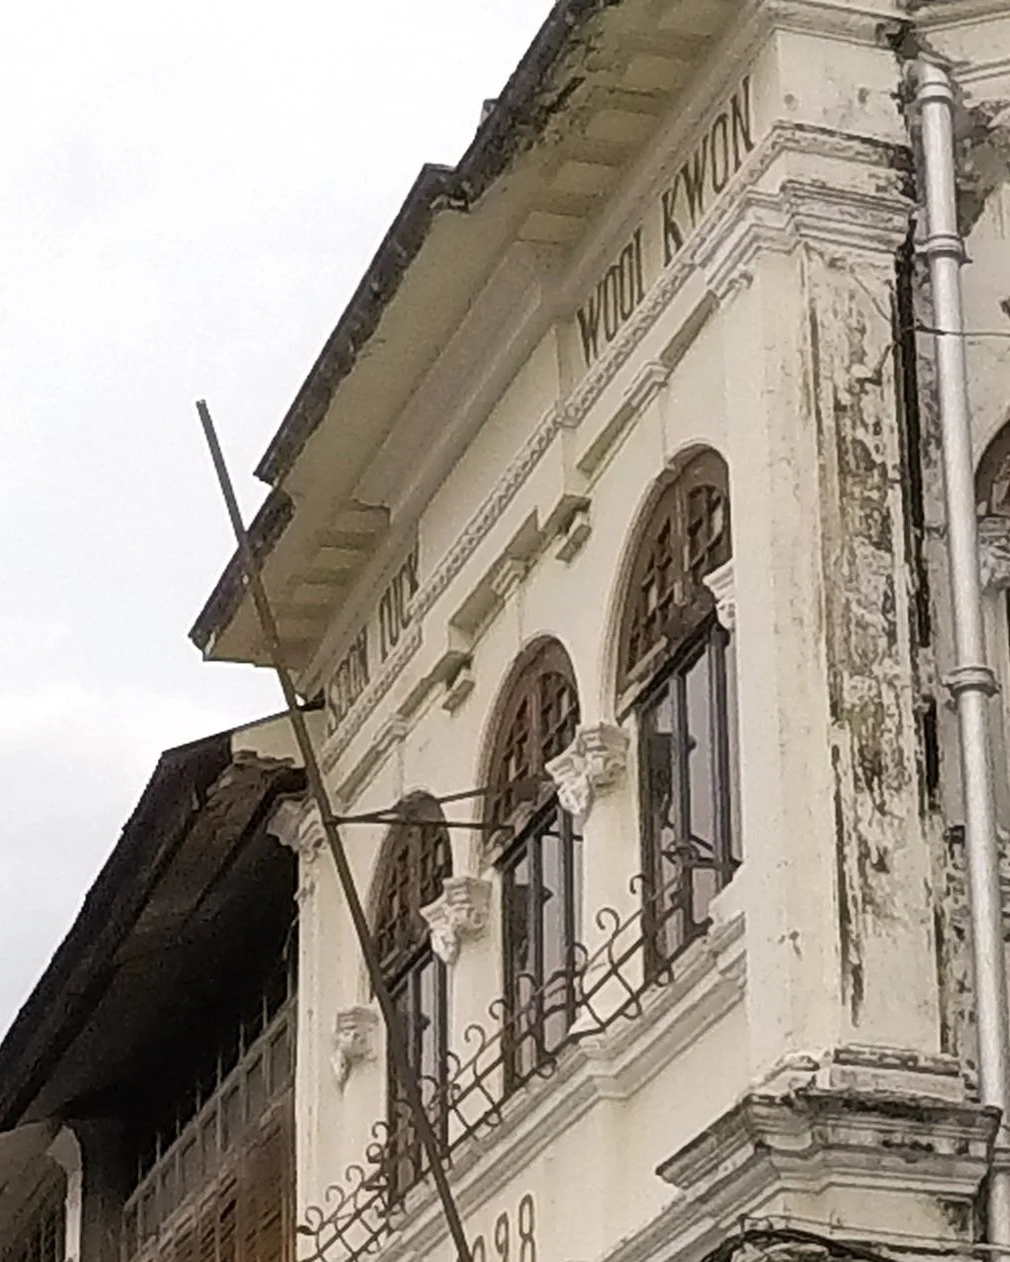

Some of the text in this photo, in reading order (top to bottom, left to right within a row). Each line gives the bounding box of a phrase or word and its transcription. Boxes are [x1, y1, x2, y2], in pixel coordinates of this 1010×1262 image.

[378, 541, 420, 663] TUCK
[576, 225, 646, 368] WOOI
[660, 74, 755, 268] KWON
